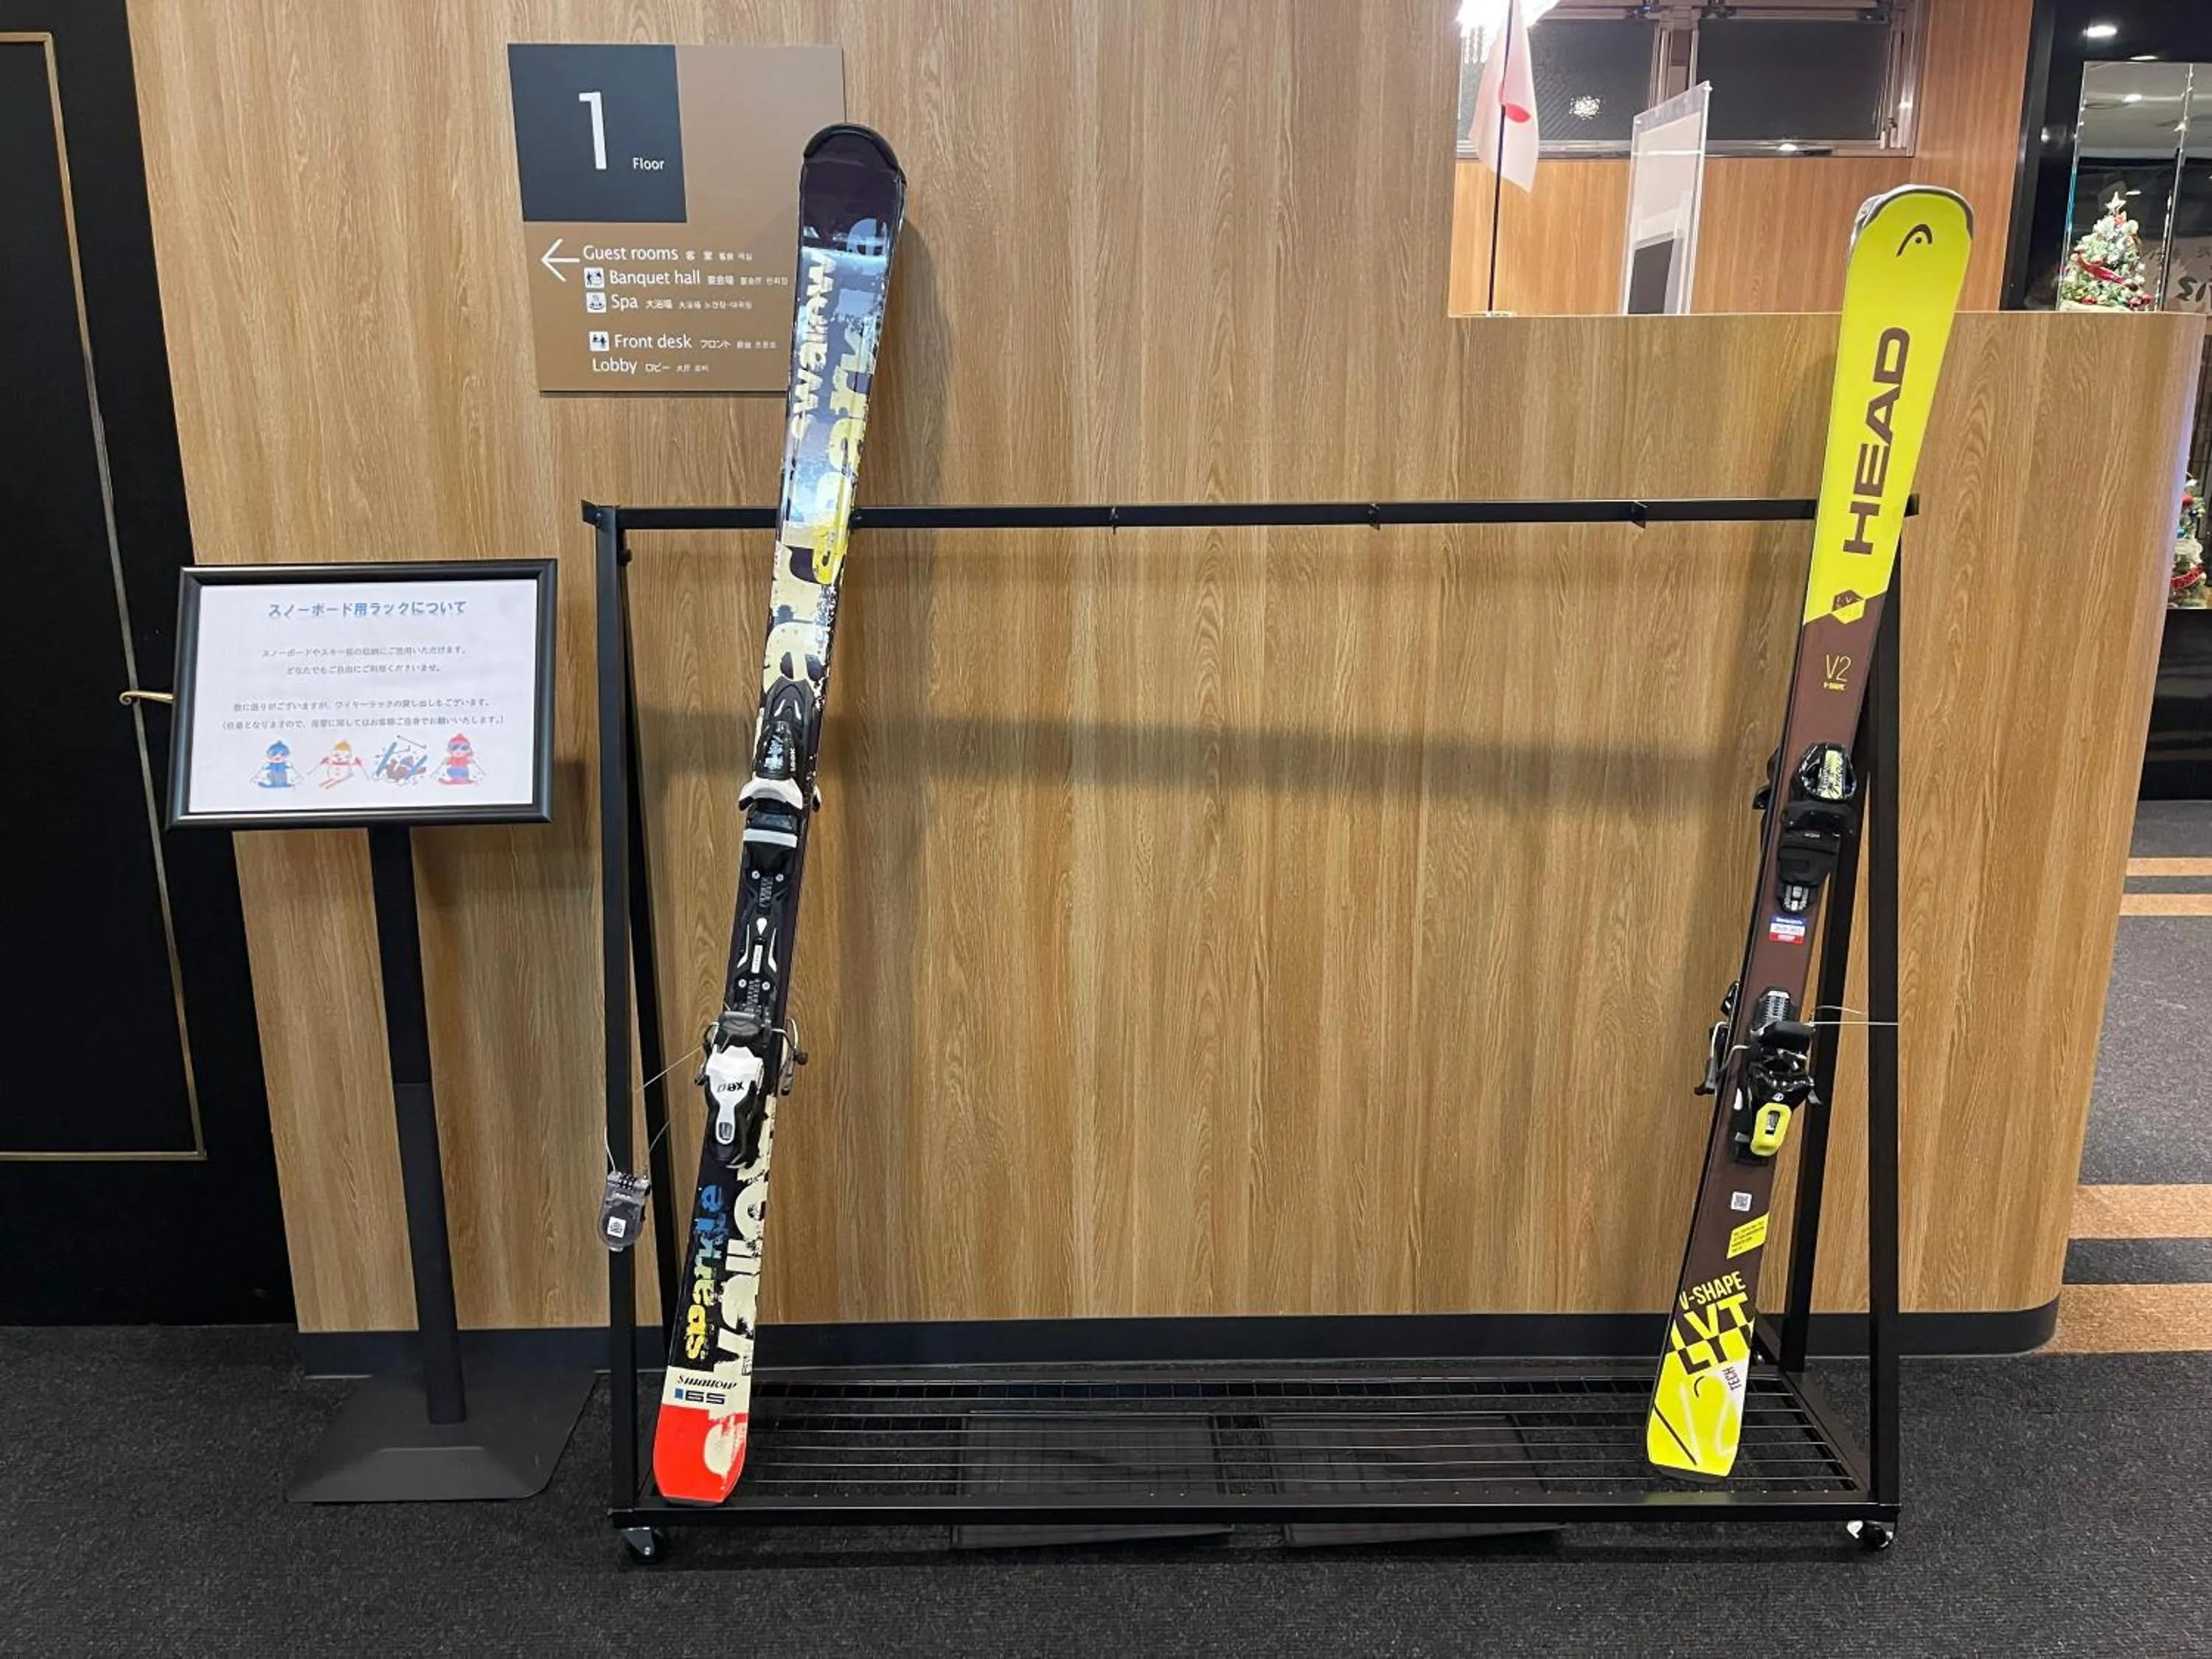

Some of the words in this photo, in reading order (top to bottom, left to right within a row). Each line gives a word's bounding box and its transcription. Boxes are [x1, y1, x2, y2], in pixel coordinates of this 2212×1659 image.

[578, 91, 607, 170] 1
[633, 157, 665, 170] Floor
[583, 245, 627, 260] Guest
[631, 247, 679, 260] rooms
[610, 269, 670, 287] Banquet
[675, 269, 700, 284] hall
[611, 295, 638, 310] Spa
[614, 334, 653, 349] Front
[658, 333, 692, 349] desk
[700, 340, 731, 349] フロント
[592, 358, 637, 375] Lobby
[645, 363, 670, 372] ロビー
[1843, 327, 1910, 555] HEAD
[268, 600, 467, 619] スノーボード用ラックについて
[1826, 654, 1851, 682] V2
[1679, 1270, 1746, 1310] V-SHAPE
